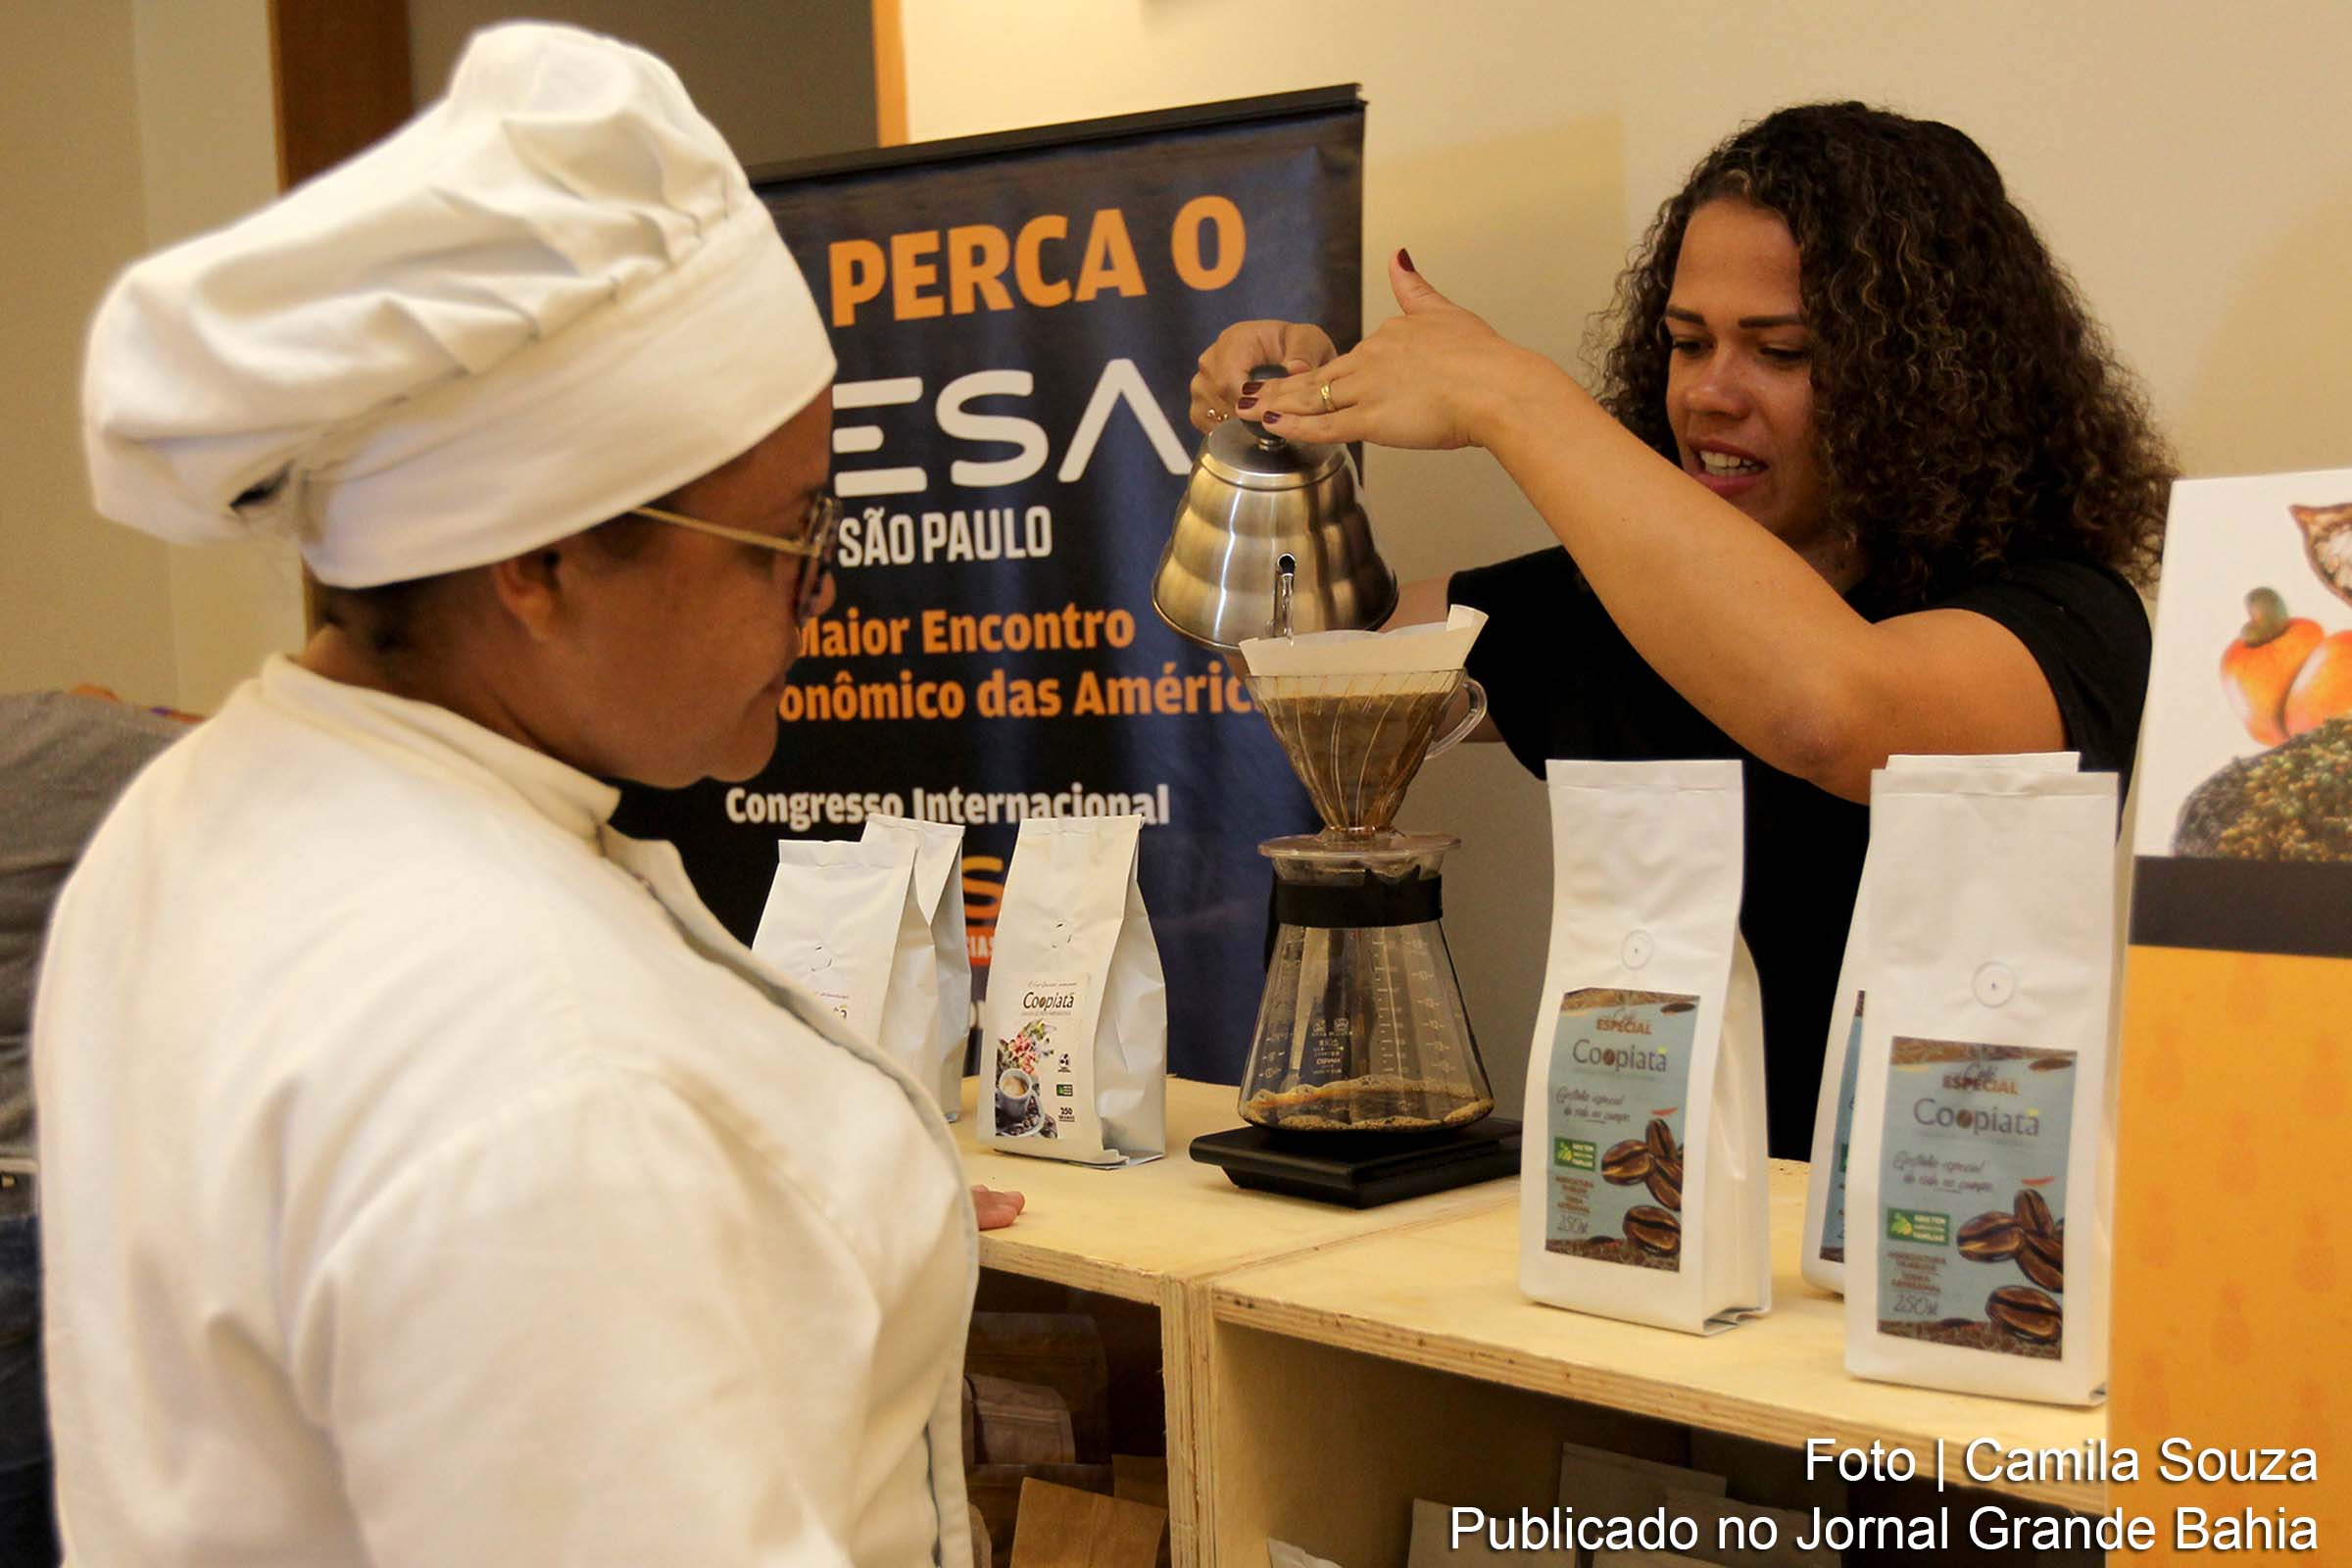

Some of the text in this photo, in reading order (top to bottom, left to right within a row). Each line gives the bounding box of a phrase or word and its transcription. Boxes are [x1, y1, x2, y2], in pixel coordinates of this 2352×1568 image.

[828, 196, 1247, 327] PERCA O
[832, 359, 1193, 498] ESA
[838, 506, 1053, 567] SÃO PAULO
[922, 602, 1135, 656] Encontro
[779, 660, 1252, 722] onômico das Améric
[725, 782, 1170, 832] Congresso Internacional
[1597, 1018, 1653, 1036] ESPECIAL
[1942, 1073, 2018, 1095] ESPECIAL
